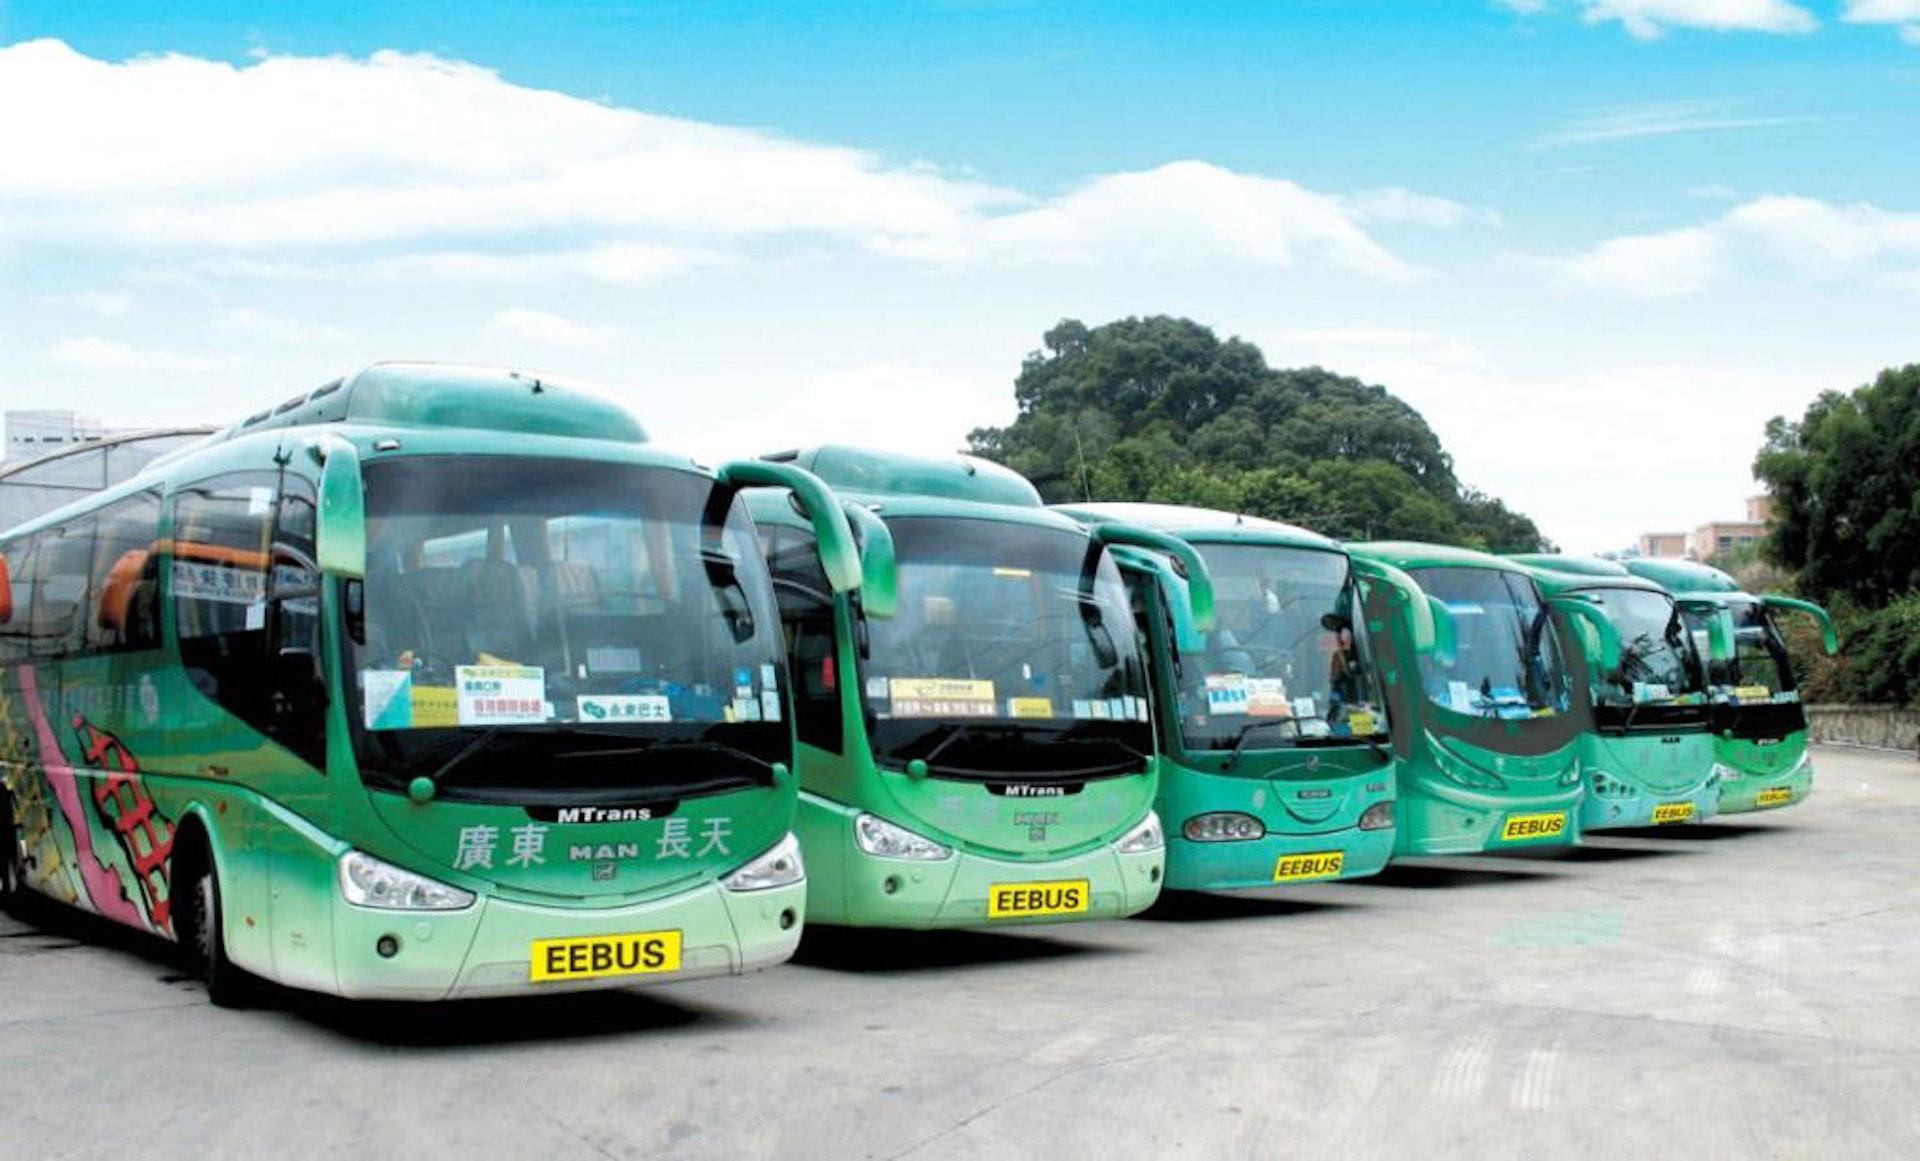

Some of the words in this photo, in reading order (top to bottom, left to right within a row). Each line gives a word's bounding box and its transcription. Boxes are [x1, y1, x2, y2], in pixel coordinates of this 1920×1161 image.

[1005, 785, 1064, 797] MTrans
[557, 807, 652, 823] MTrans
[1655, 804, 1693, 819] EEBUS
[1507, 817, 1562, 837] EEBUS
[452, 823, 549, 871] 廣東
[569, 843, 638, 860] MAN
[1278, 856, 1341, 876] EEBUS
[997, 888, 1080, 912] EEBUS
[546, 940, 666, 974] EEBUS
